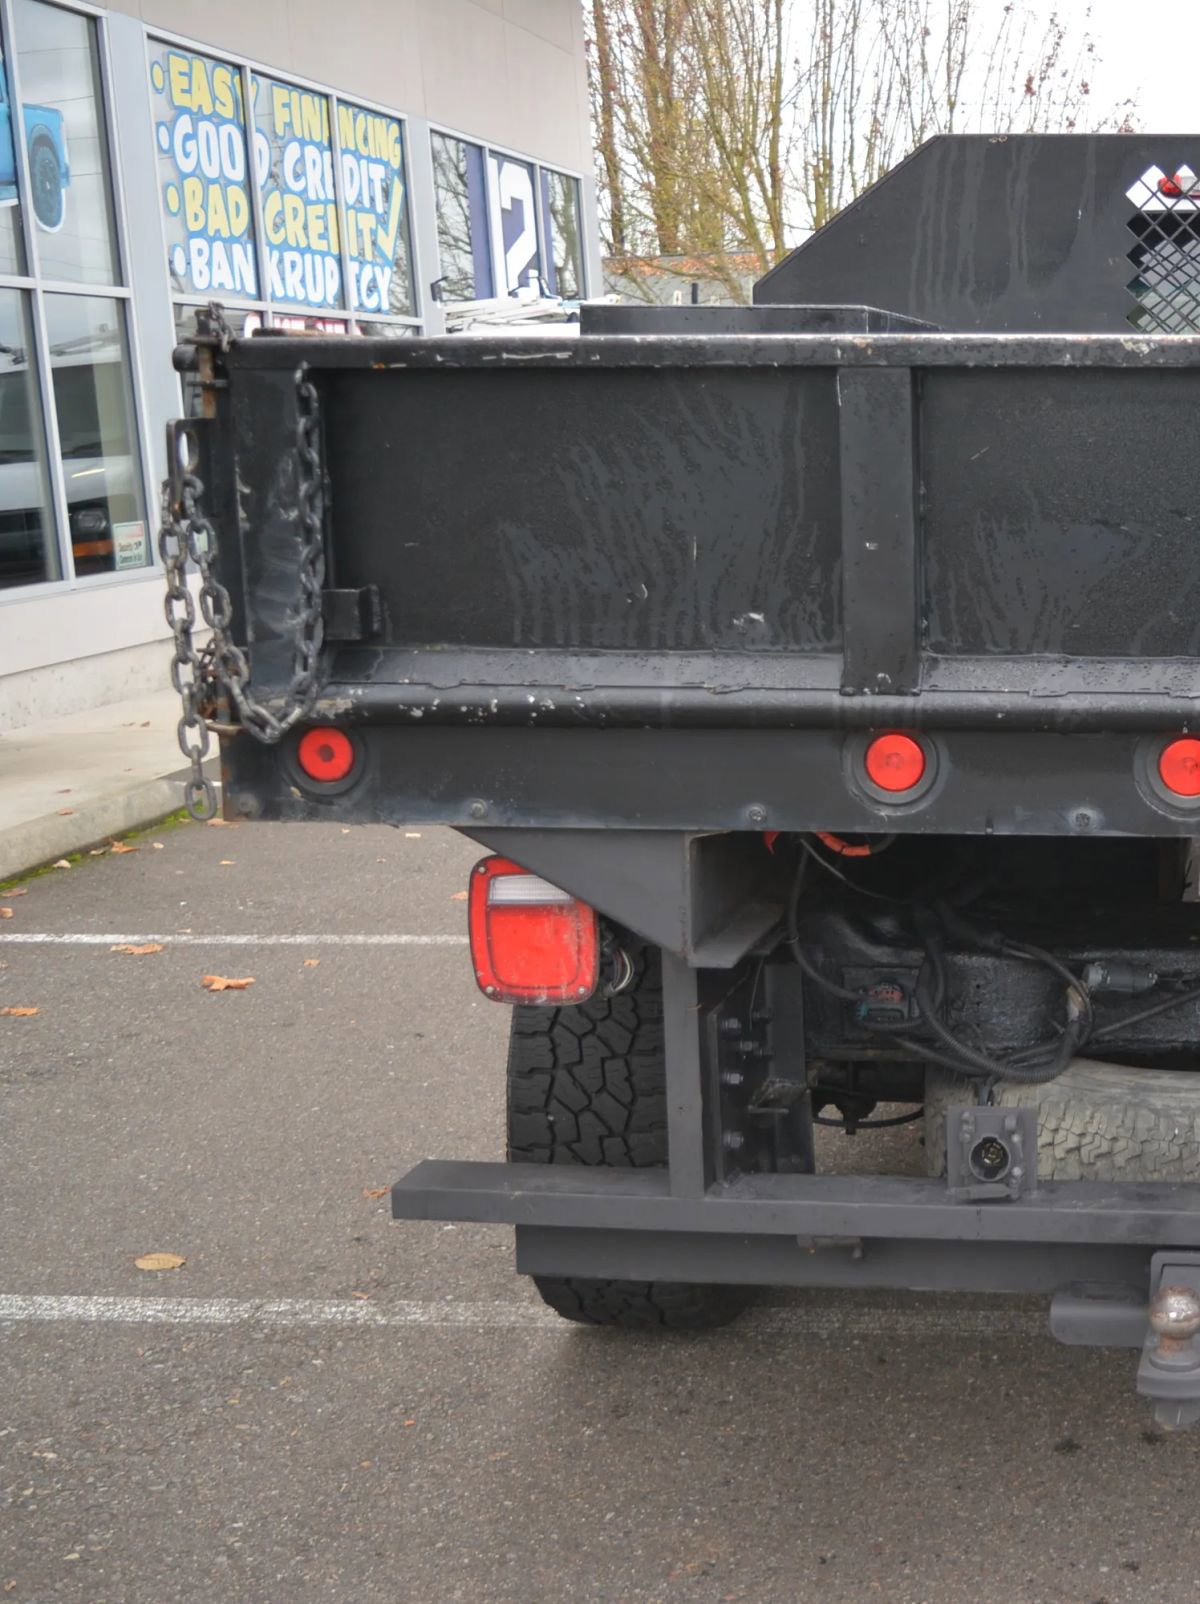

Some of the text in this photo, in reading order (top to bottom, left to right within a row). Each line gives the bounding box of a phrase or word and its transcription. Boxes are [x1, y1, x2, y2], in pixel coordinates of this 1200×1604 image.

[174, 114, 269, 188] GOOD
[183, 177, 248, 238] BAD
[189, 238, 391, 311] BANKRUPTCY
